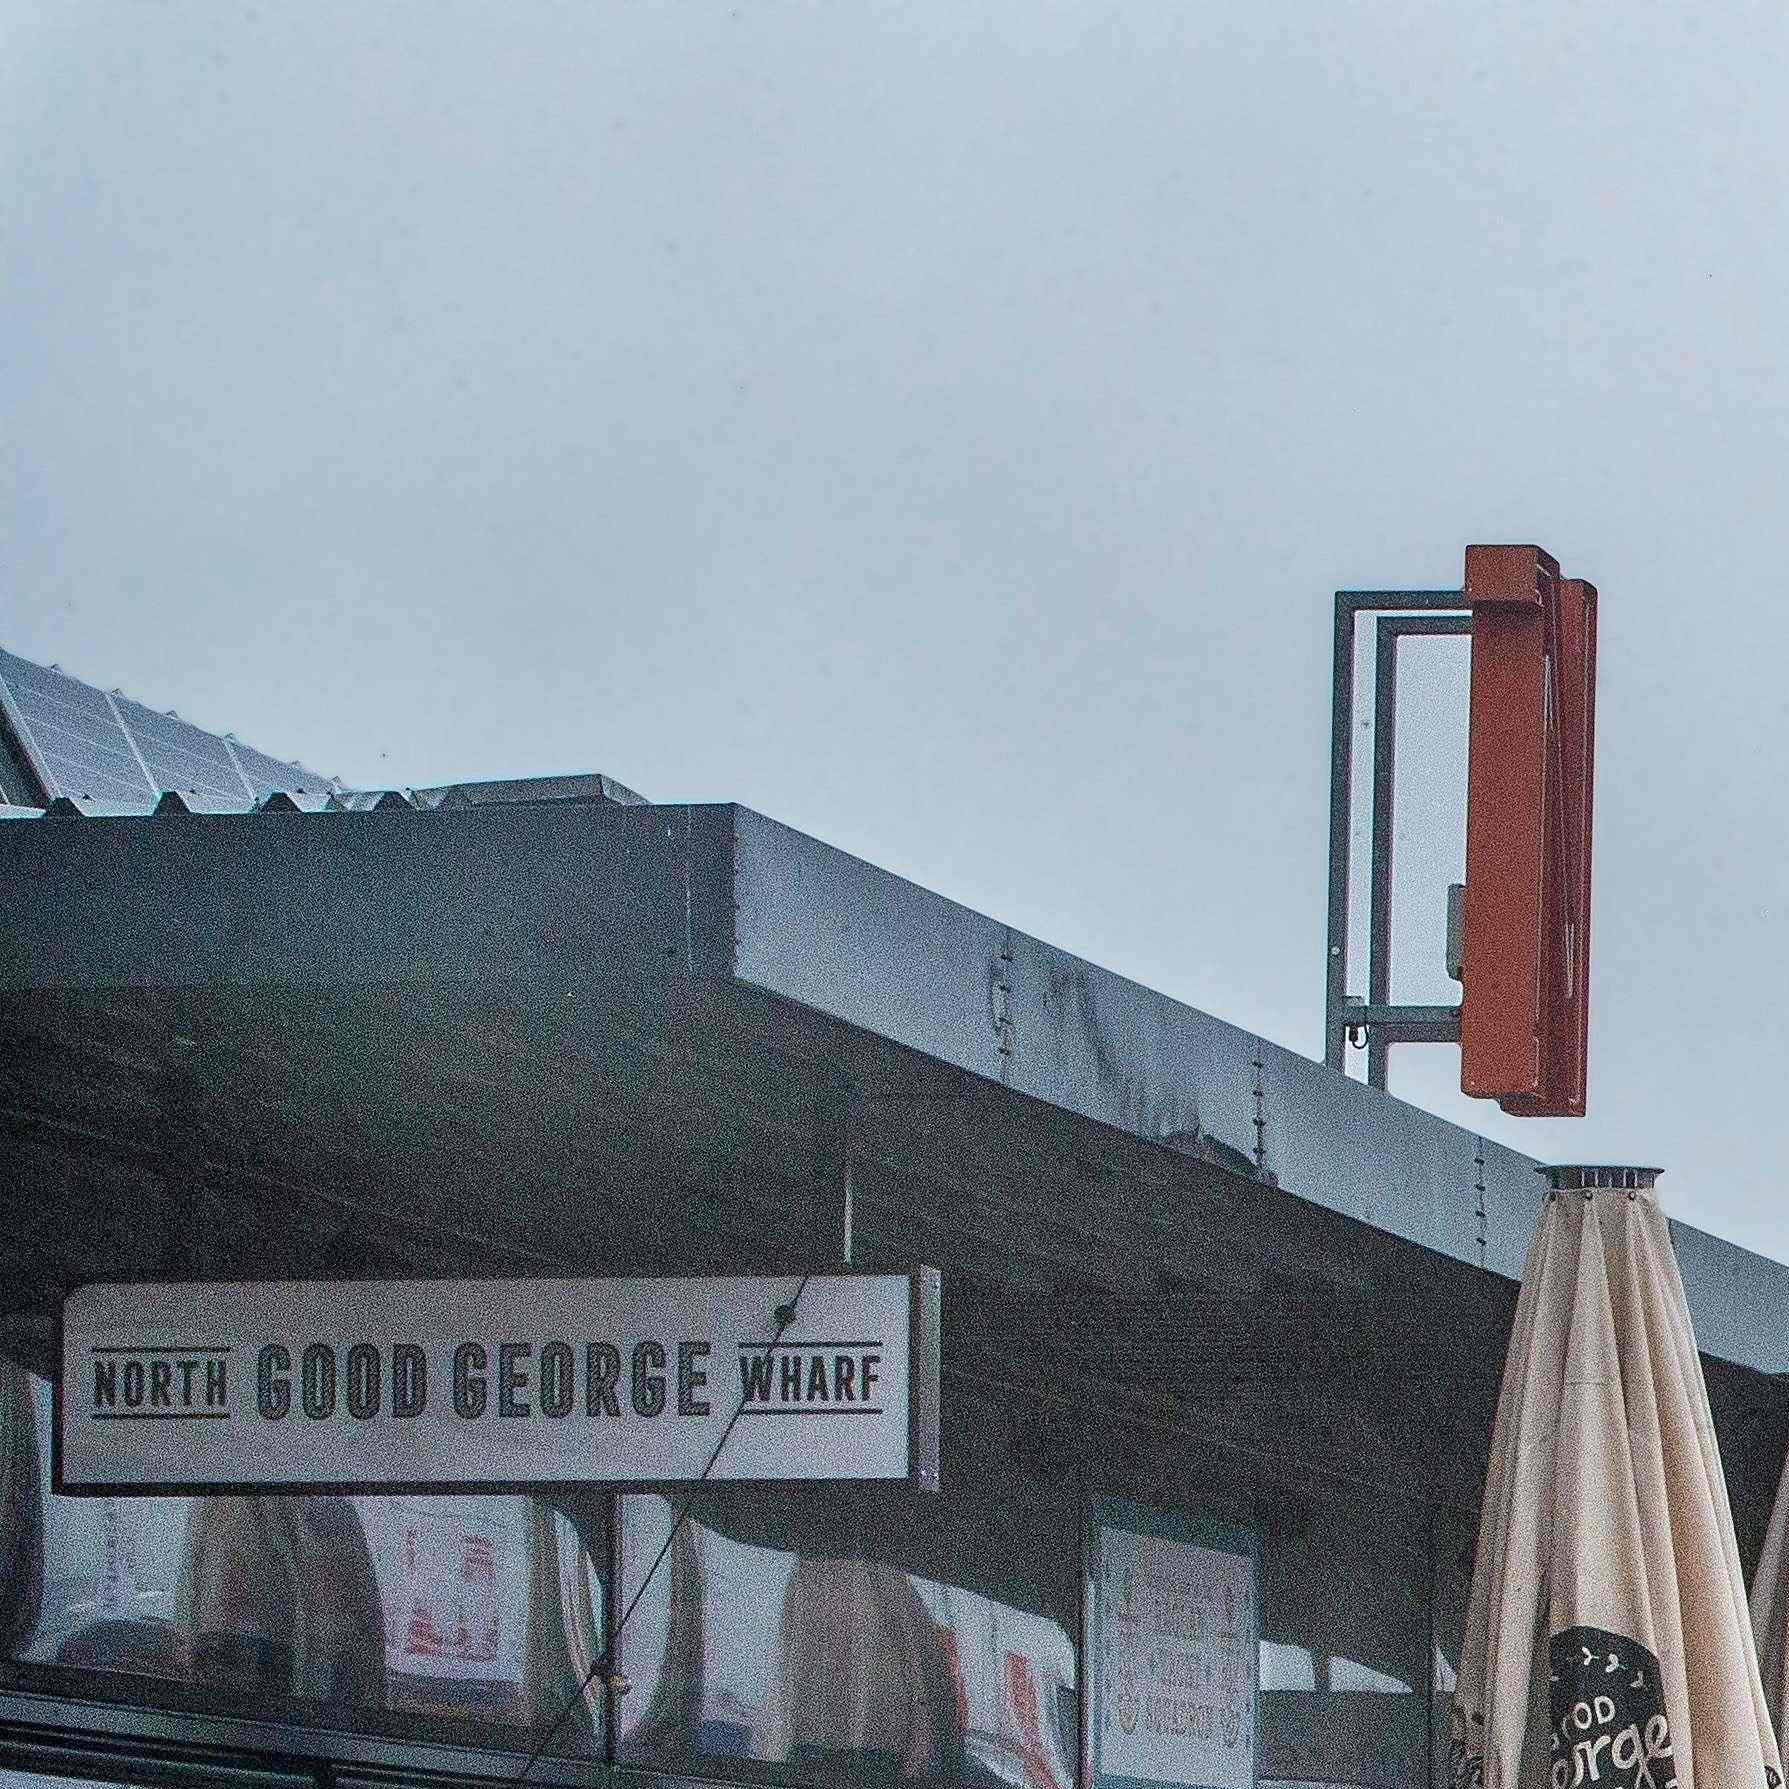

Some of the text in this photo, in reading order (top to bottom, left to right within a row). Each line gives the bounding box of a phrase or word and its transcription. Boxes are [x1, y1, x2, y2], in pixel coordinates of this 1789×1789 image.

[92, 1340, 882, 1421] NORTH GOOD GEORGE WHARF
